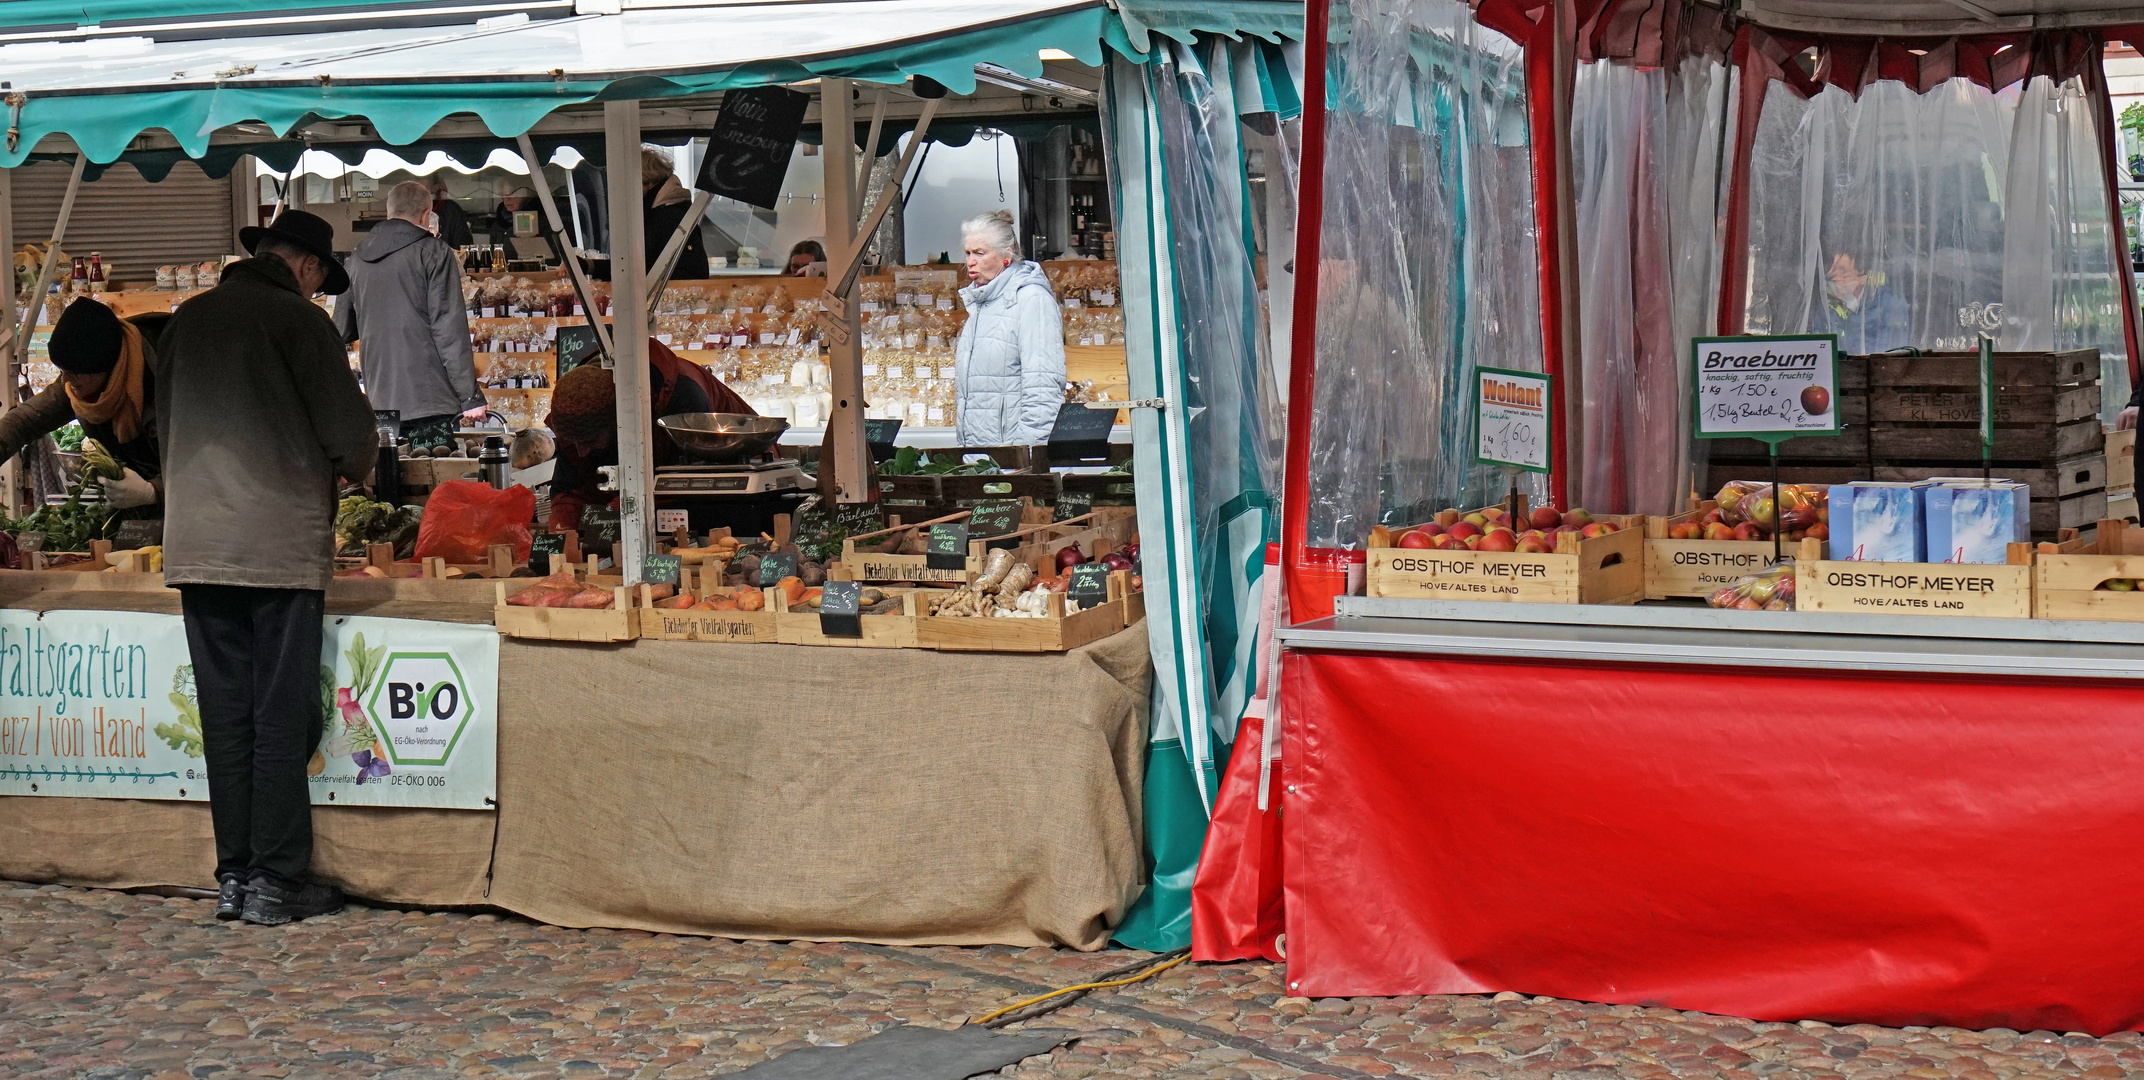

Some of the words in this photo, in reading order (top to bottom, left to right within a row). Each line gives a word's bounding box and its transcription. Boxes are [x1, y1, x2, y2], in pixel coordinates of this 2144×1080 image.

[1704, 350, 1817, 369] Braeburn
[1706, 373, 1739, 382] knackig,
[1745, 372, 1773, 382] saftig,
[1778, 371, 1813, 381] fruchtig
[1483, 378, 1542, 407] Wellant
[1700, 386, 1705, 394] 1
[1709, 386, 1721, 395] Kg
[1900, 395, 1953, 406] PETER
[1965, 395, 2021, 406] MER
[1738, 402, 1779, 417] Beutel
[1940, 409, 1981, 420] HOVE
[1993, 409, 2012, 420] 35
[836, 503, 881, 523] Bärlauch
[1674, 552, 1758, 566] OBSTHOF
[864, 563, 899, 580] Eichdorfer
[1392, 558, 1474, 575] OBSTHOF
[1483, 563, 1546, 577] MEYER
[1420, 582, 1487, 593] HOVE/ALTES
[1493, 585, 1519, 595] LAND
[1827, 572, 1918, 589] OBSTHOF
[1924, 576, 1994, 592] MEYER
[1854, 597, 1928, 608] HOVE/ALTES
[1934, 600, 1964, 610] LAND
[663, 616, 698, 634] Eichdorfer
[700, 617, 755, 638] Vielfaltsgarten
[0, 716, 30, 757] erz
[49, 717, 85, 758] von
[93, 706, 147, 759] Hand
[394, 736, 447, 747] EG-Öko-Verordnung
[391, 773, 424, 786] DE-ÖKO
[427, 775, 446, 787] 006
